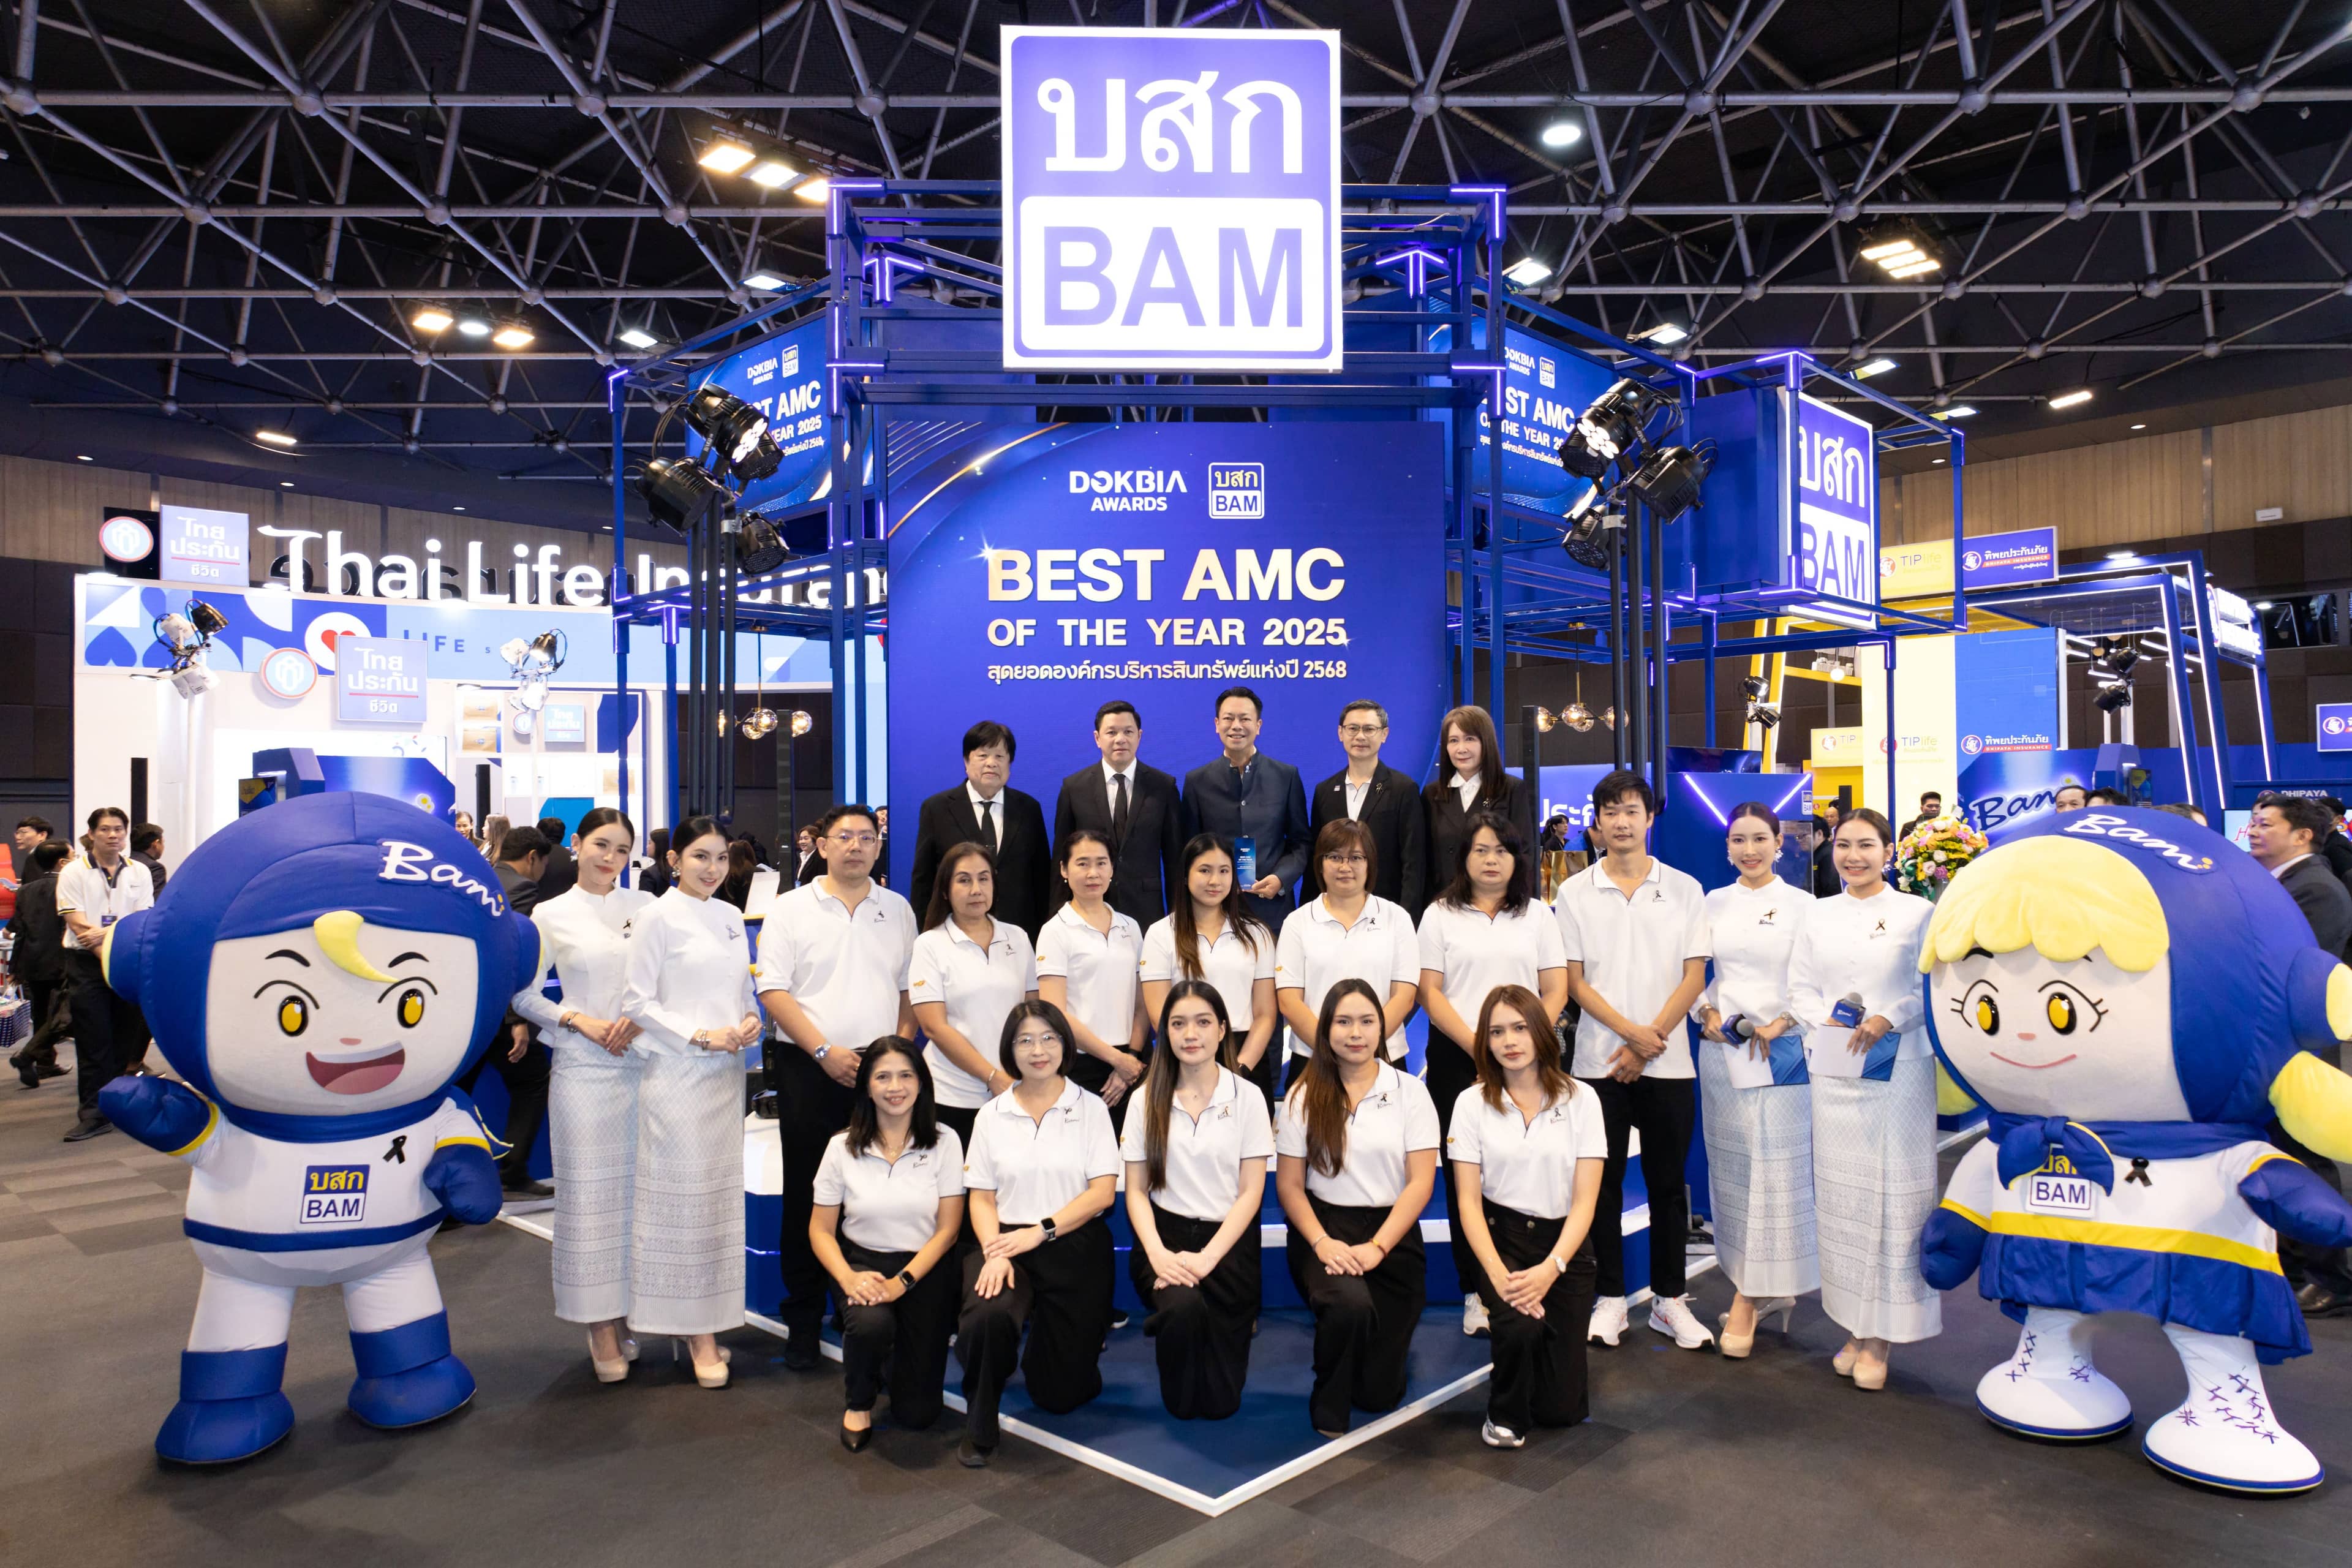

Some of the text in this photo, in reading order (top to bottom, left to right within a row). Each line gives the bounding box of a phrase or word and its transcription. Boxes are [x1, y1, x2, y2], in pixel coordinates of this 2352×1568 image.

[1038, 71, 1302, 173] บสก
[1044, 226, 1303, 327] BAM
[776, 380, 821, 421] AMC
[1533, 398, 1575, 434] AMC
[772, 415, 822, 442] EAR 2025
[1524, 426, 1550, 448] YEAR
[1800, 425, 1864, 508] บสก
[1070, 470, 1187, 493] DOKBIA
[1216, 469, 1257, 488] บสก
[1091, 497, 1167, 511] AWARDS
[1216, 496, 1257, 512] BAM
[176, 516, 225, 540] ไทย
[170, 537, 239, 560] ประกัน
[1985, 545, 2048, 560] ทิพยประกันภัย
[191, 564, 220, 578] ชีวิต
[257, 525, 442, 601] Thai
[468, 541, 604, 606] Life
[1800, 521, 1864, 603] BAM
[987, 548, 1345, 601] BEST AMC
[987, 618, 1347, 646] OF THE YEAR 2025
[353, 647, 404, 671] ไทย
[347, 670, 418, 692] ประกัน
[987, 658, 1347, 685] สุดยอดองค์กรบริหารสินทรัพย์แห่งปี 2568
[369, 699, 398, 713] ชีวิต
[1985, 734, 2048, 745] ทิพยประกันภัย
[310, 1170, 364, 1191] บสก
[2037, 1182, 2086, 1204] BAM
[307, 1198, 360, 1218] BAM
